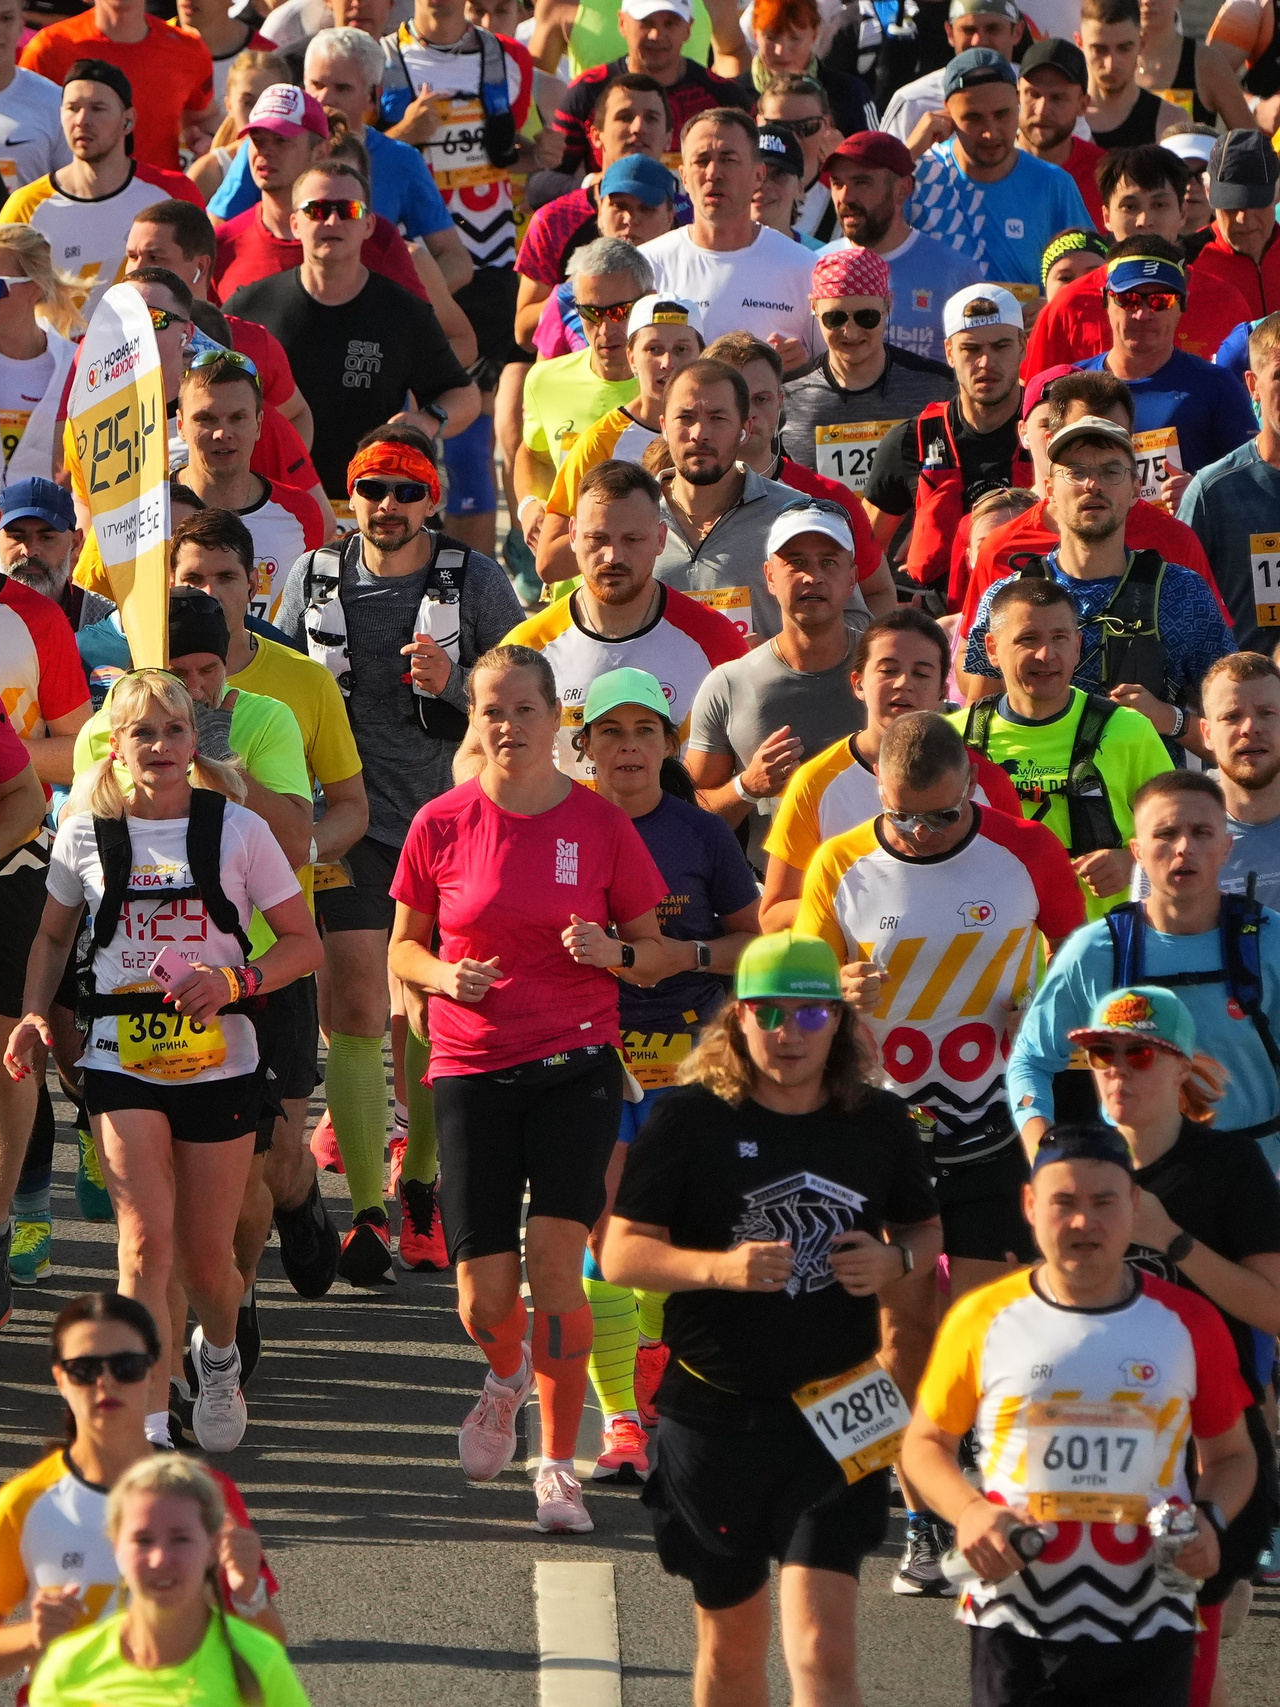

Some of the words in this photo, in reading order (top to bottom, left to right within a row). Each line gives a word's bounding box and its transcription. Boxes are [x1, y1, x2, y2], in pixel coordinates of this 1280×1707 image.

[742, 299, 794, 313] Alexander
[1258, 560, 1280, 588] 1
[563, 688, 583, 701] GRi
[556, 838, 579, 858] Sat
[556, 857, 578, 872] 9AM
[555, 870, 578, 886] 5KM
[880, 916, 900, 930] GRi
[152, 1040, 188, 1052] ИРИНА
[1031, 1364, 1053, 1380] GRi
[815, 1378, 900, 1441] 12878
[1043, 1435, 1138, 1472] 6017
